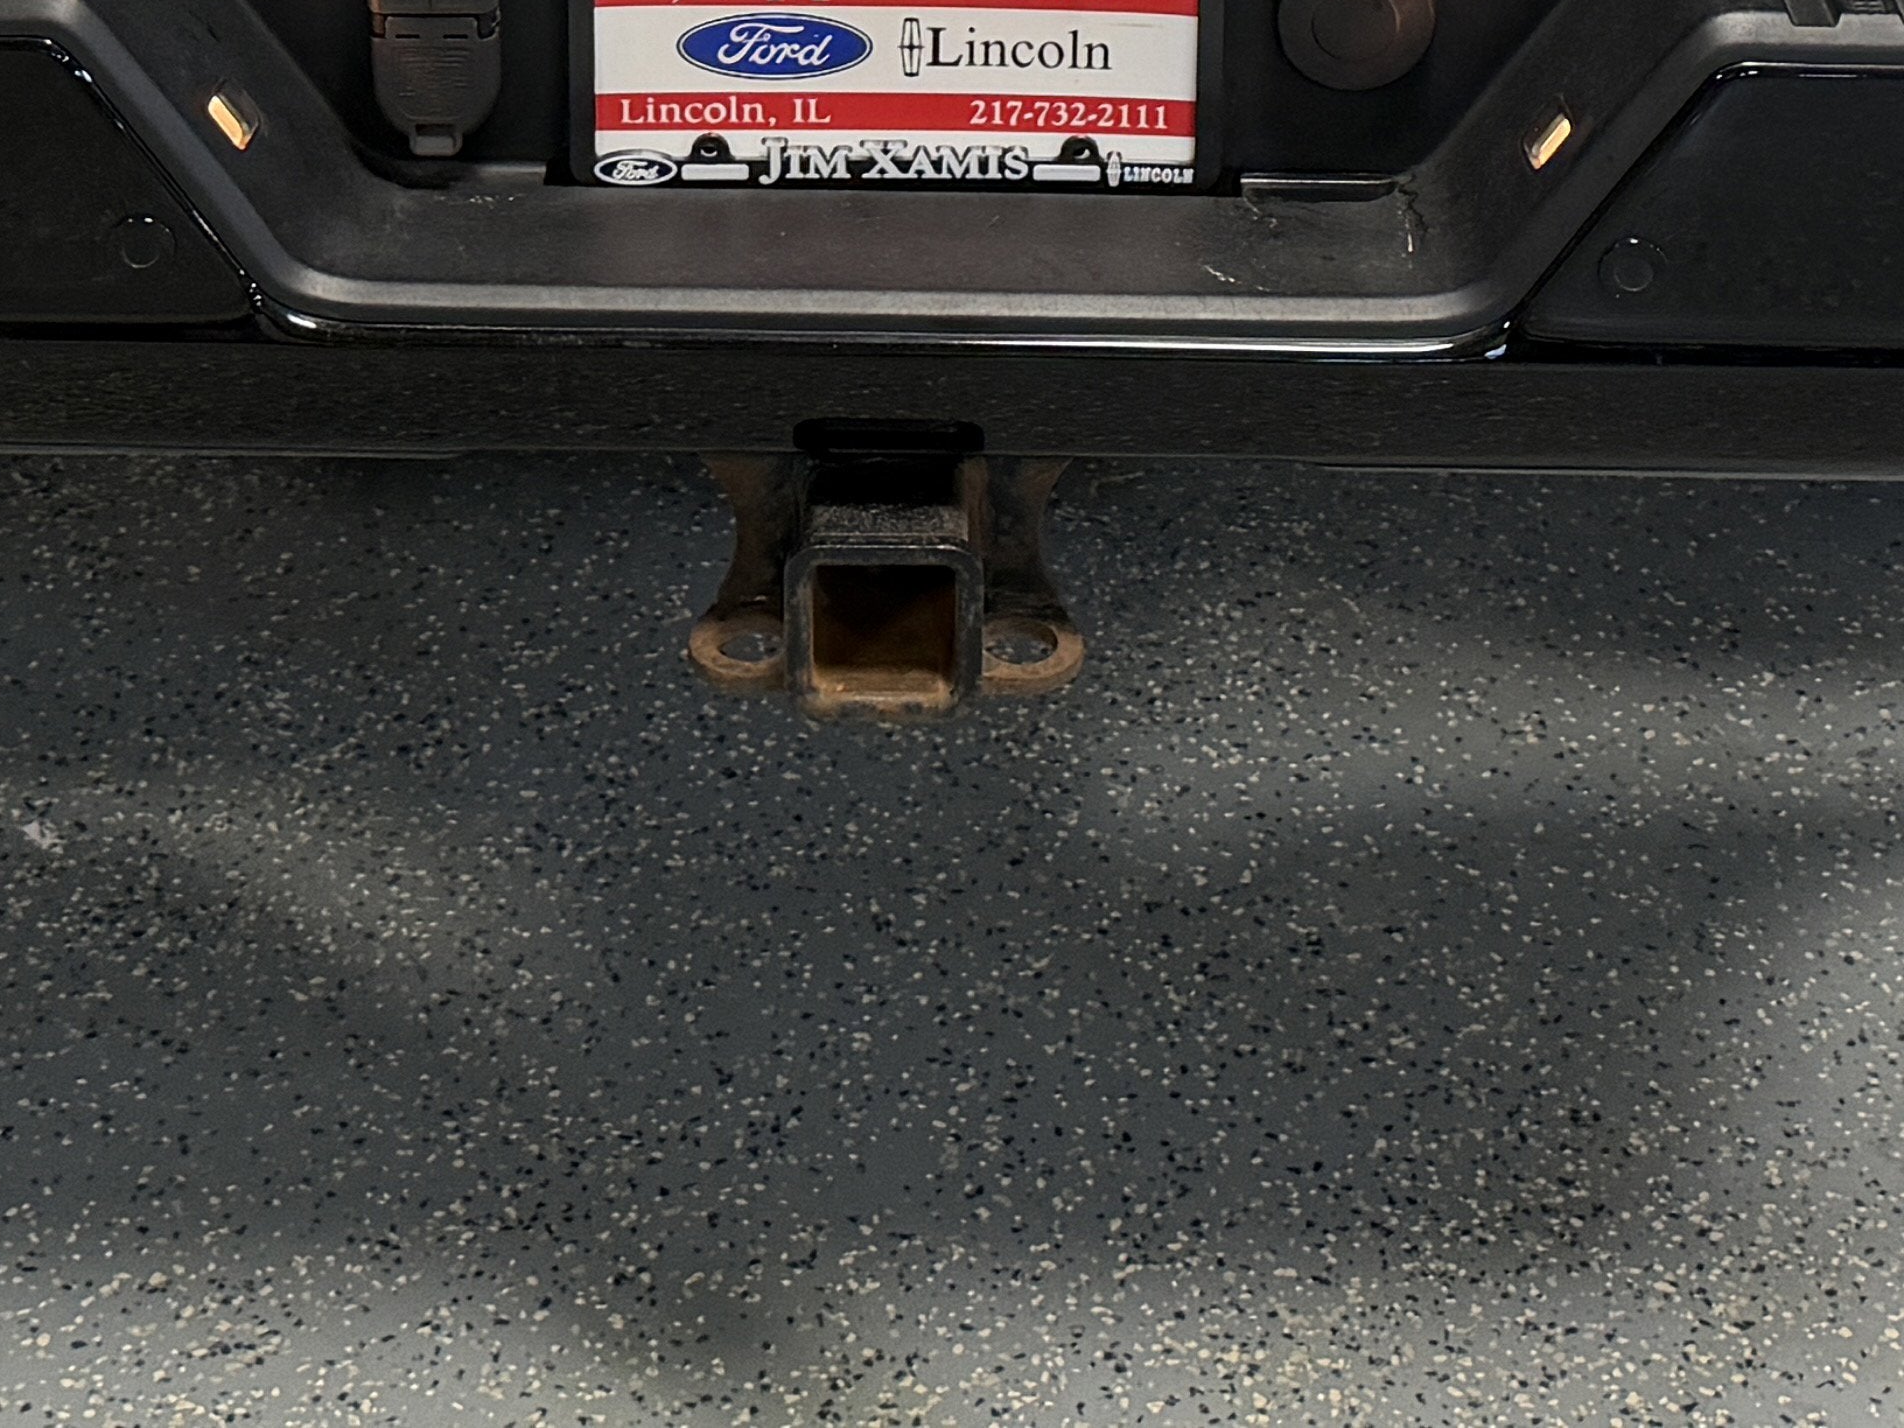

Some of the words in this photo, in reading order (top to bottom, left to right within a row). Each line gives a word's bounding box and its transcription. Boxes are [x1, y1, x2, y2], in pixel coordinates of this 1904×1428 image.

[716, 21, 834, 67] Ford
[927, 26, 1112, 70] Lincoln
[619, 97, 778, 129] Lincoln,
[792, 98, 832, 125] IL
[969, 99, 1169, 130] 217-732-2111
[612, 160, 660, 181] Ford
[758, 137, 851, 185] JIM
[859, 139, 1032, 183] XAMIS
[1123, 165, 1194, 184] LINCOLN
